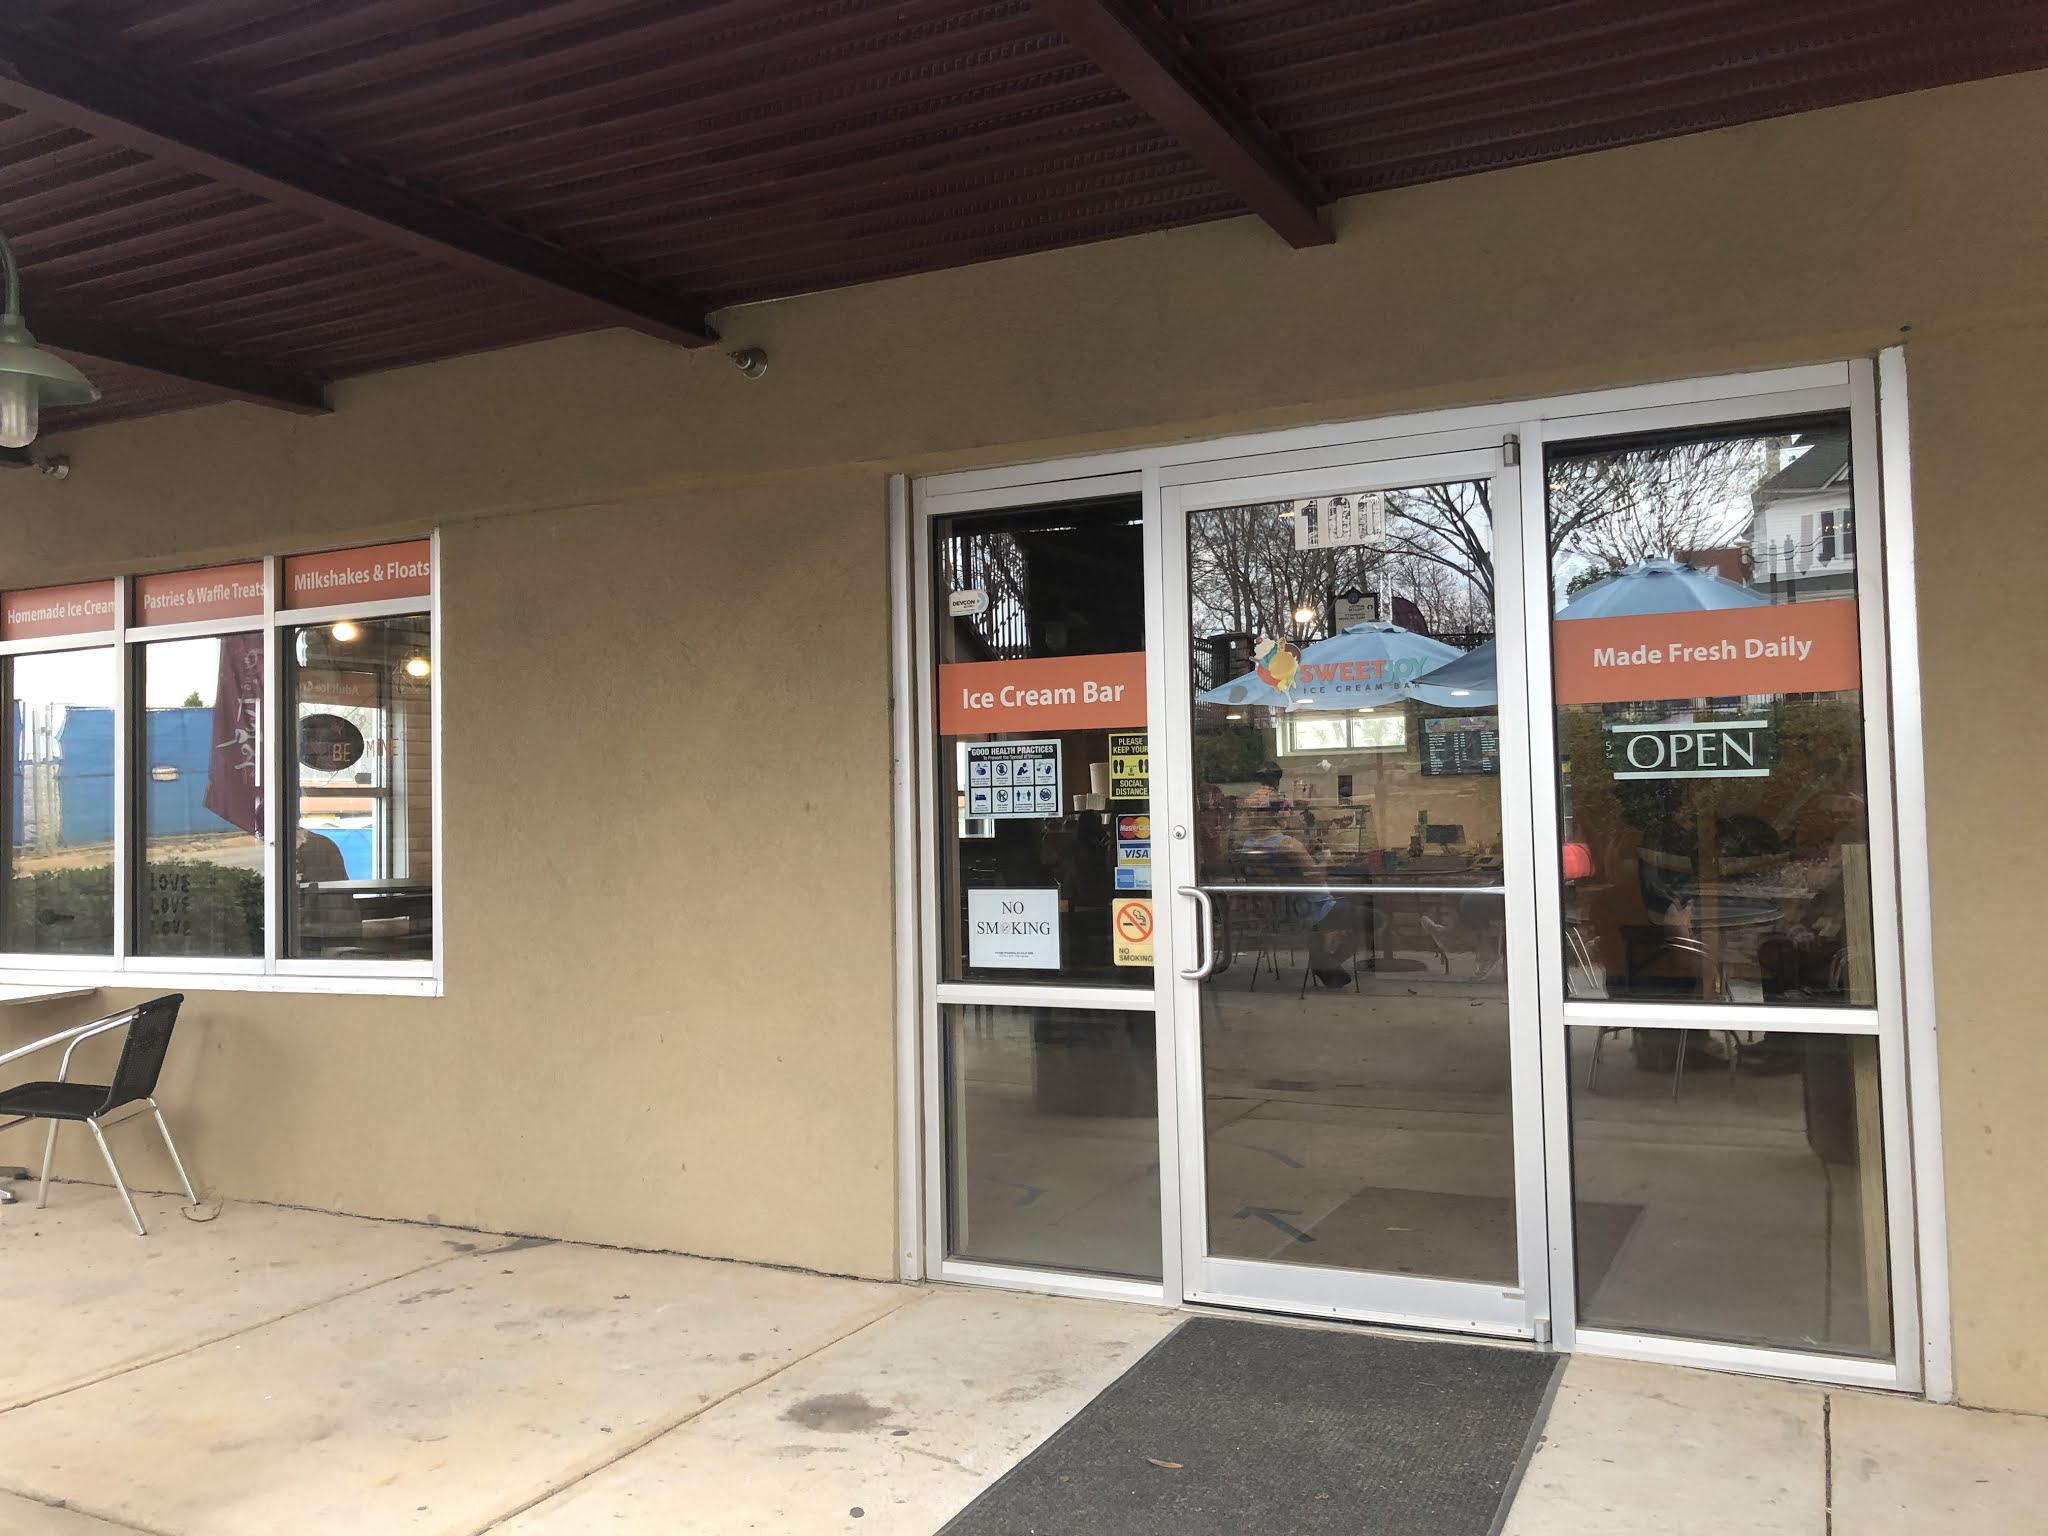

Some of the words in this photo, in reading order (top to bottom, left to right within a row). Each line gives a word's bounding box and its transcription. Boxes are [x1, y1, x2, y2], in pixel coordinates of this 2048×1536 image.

[1301, 493, 1381, 547] 100
[294, 567, 370, 591] Milkshakes
[373, 564, 383, 581] &
[387, 561, 430, 580] Floats
[144, 591, 185, 610] Pastries
[187, 589, 195, 604] &
[197, 584, 230, 603] Waffle
[232, 582, 264, 599] Treats
[7, 602, 65, 624] Homemade
[67, 602, 82, 617] Ice
[1593, 645, 1662, 667] Made
[1669, 640, 1737, 662] Fresh
[1744, 636, 1812, 661] Daily
[963, 688, 994, 709] Ice
[1000, 686, 1076, 707] Cream
[1083, 681, 1124, 703] Bar
[1303, 686, 1326, 694] ICE
[1336, 683, 1383, 693] CREAM
[1394, 682, 1421, 690] BAR
[971, 748, 989, 756] GOOD
[991, 746, 1016, 755] HEALTH
[1017, 745, 1054, 754] PRACTICES
[1113, 746, 1130, 754] KEEP
[1118, 737, 1143, 746] PLEASE
[1627, 732, 1754, 768] OPEN
[332, 743, 351, 762] BE
[1125, 849, 1149, 858] VISA
[1001, 901, 1025, 915] NO
